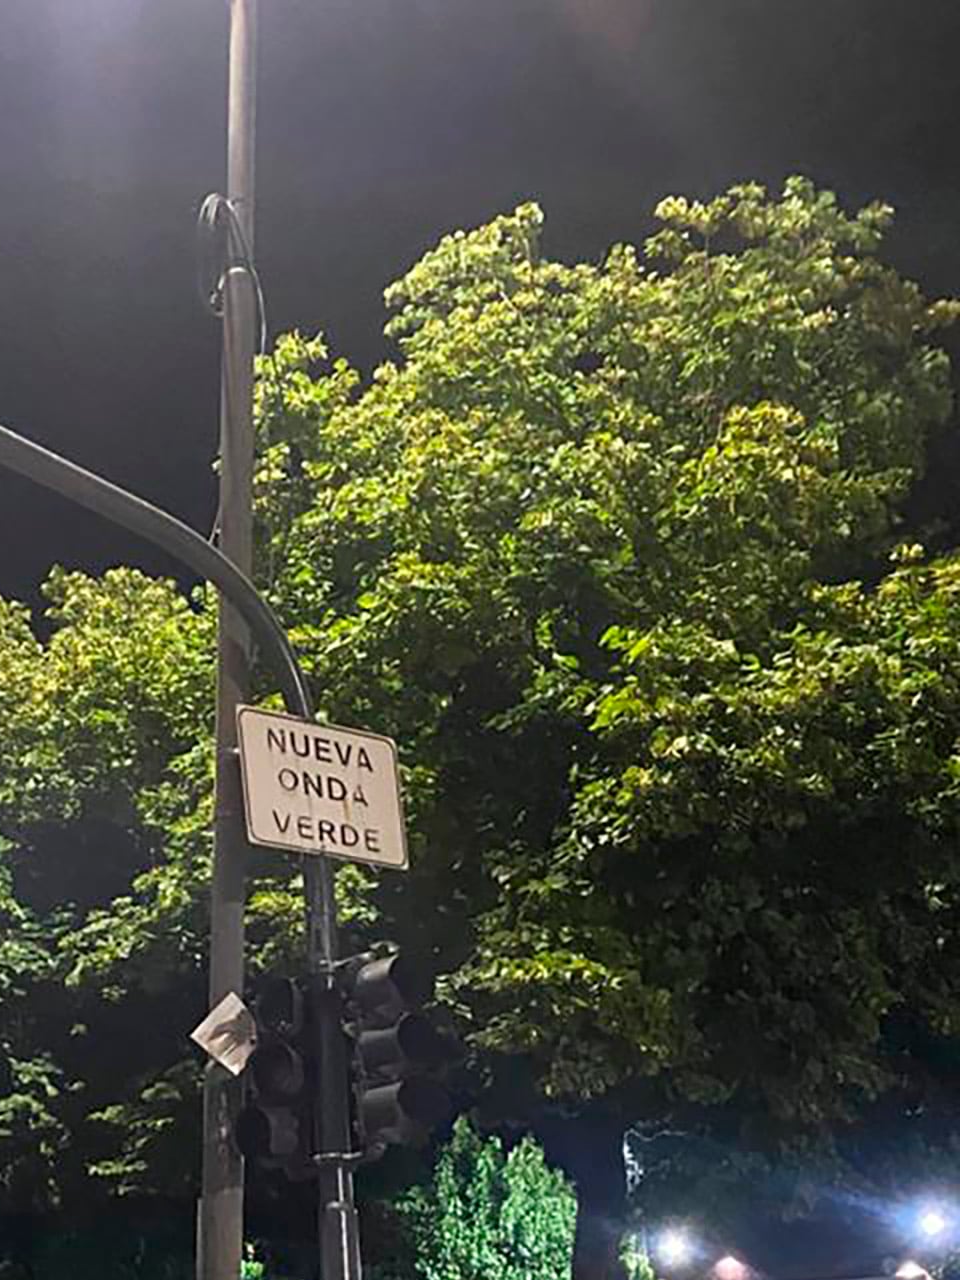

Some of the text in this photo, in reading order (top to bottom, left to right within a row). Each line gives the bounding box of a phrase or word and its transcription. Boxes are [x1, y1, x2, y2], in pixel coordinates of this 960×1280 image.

[267, 728, 373, 773] NUEVA
[278, 768, 368, 806] ONDA
[272, 810, 381, 852] VERDE
